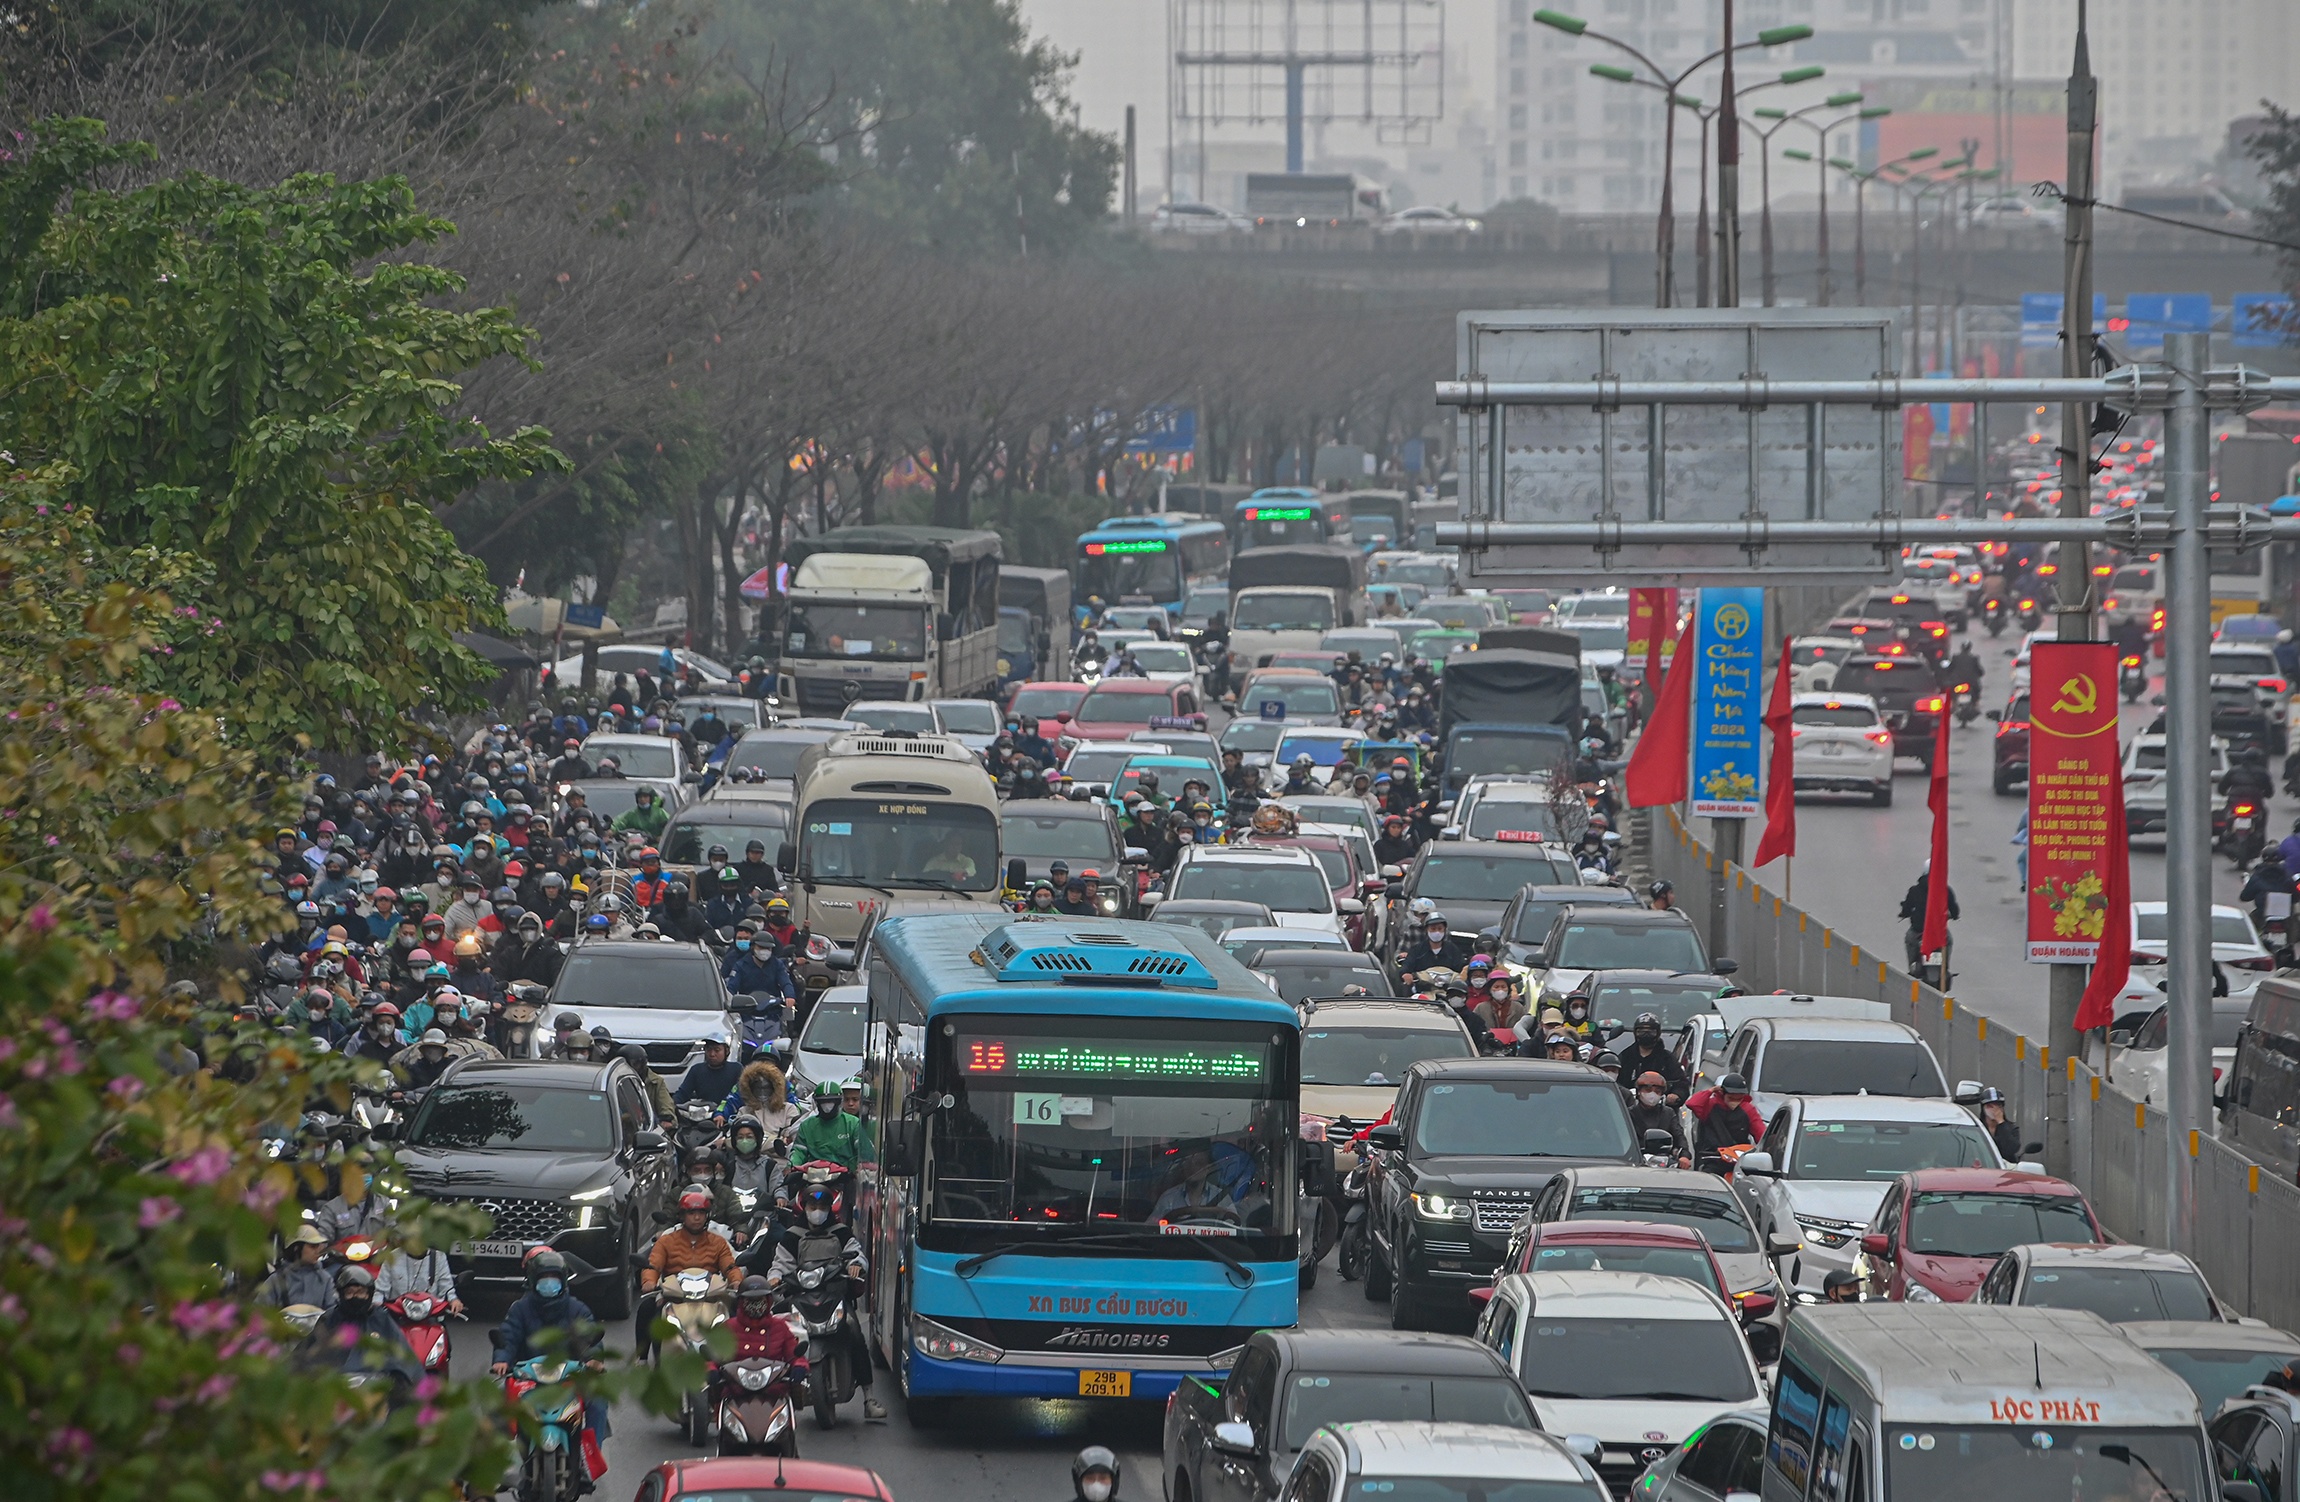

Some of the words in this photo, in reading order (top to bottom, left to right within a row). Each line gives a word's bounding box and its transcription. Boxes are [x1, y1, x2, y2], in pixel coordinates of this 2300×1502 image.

[1711, 724, 1745, 735] 2024
[879, 805, 888, 813] XE
[2031, 946, 2057, 958] QUẬN
[2059, 946, 2090, 957] HOÀNG
[970, 1042, 1005, 1069] 16
[1025, 1098, 1052, 1121] 16
[1167, 1227, 1180, 1235] 16
[456, 1242, 516, 1256] 3H-944.10
[1059, 1297, 1091, 1314] BUS
[1094, 1372, 1116, 1383] 29B
[1085, 1383, 1124, 1396] 209.11
[1989, 1396, 2034, 1425] LỘC
[2039, 1397, 2100, 1422] PHÁT
